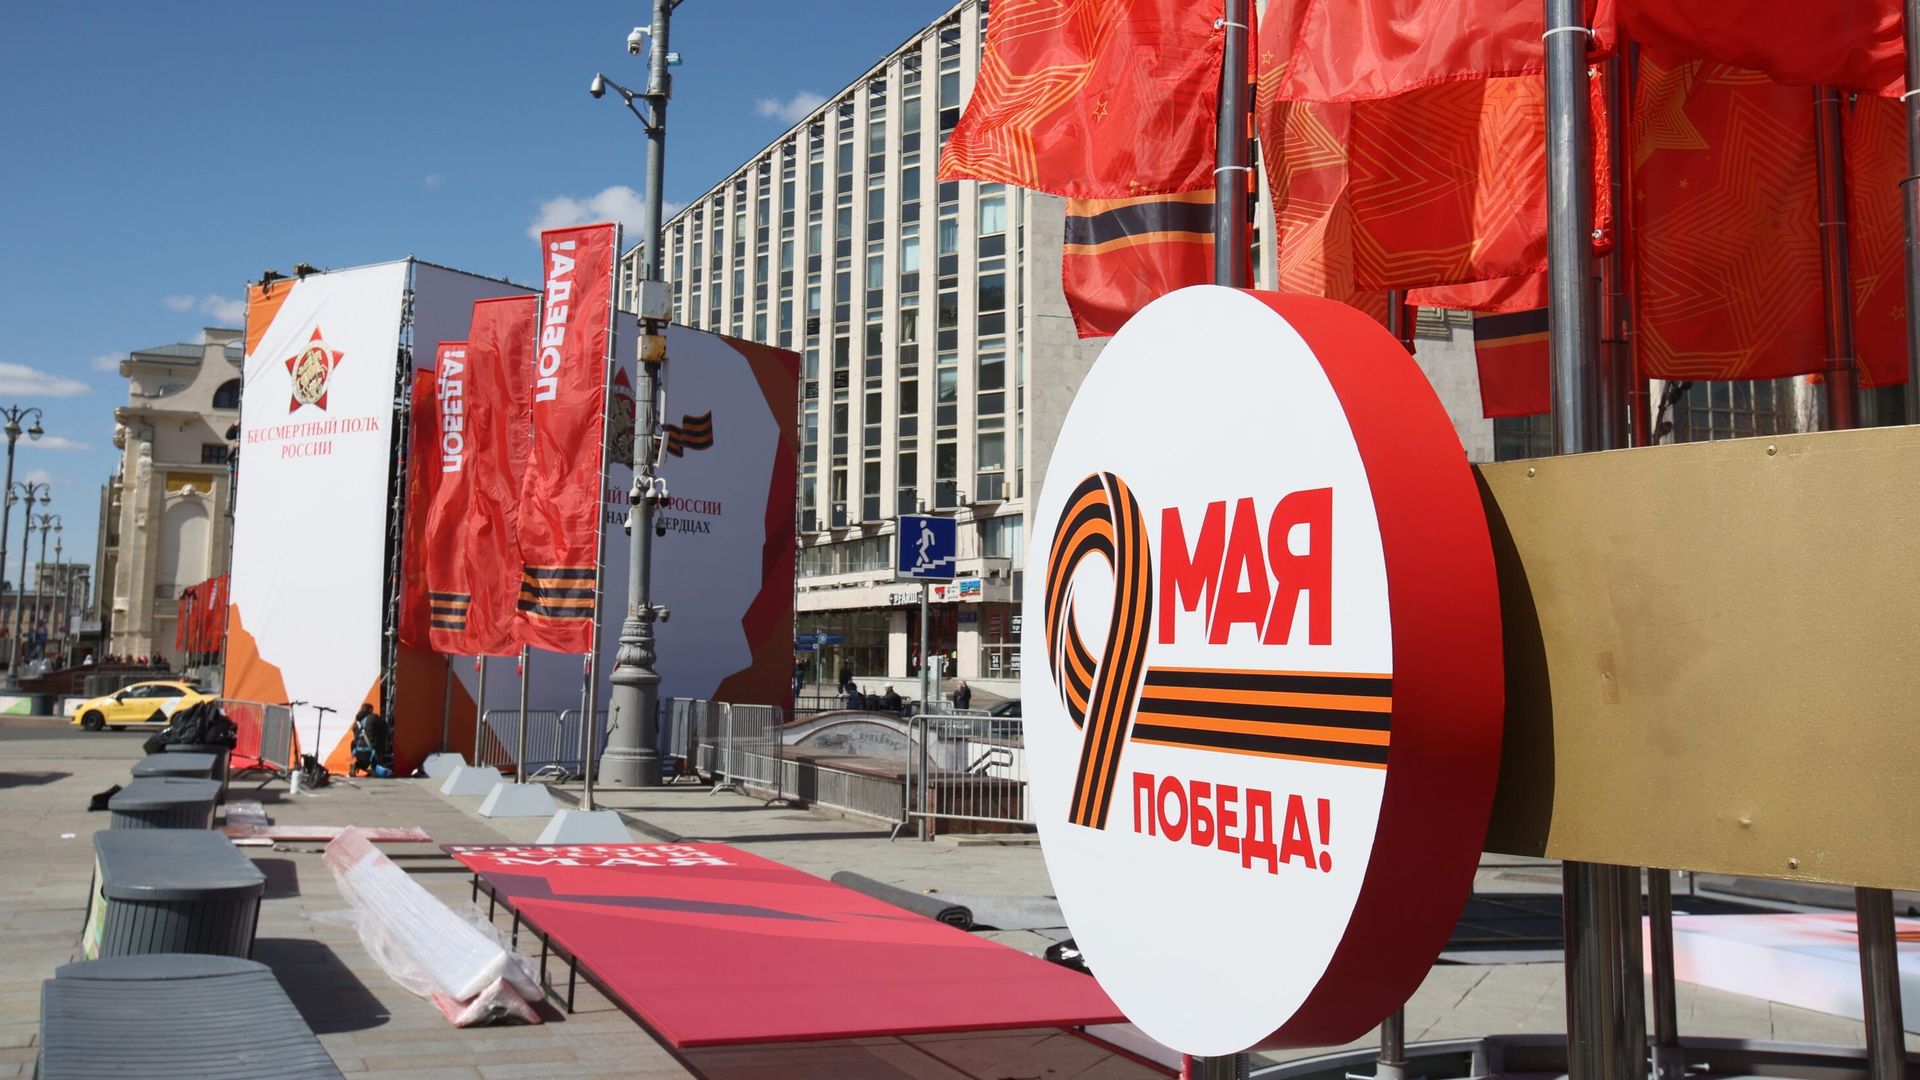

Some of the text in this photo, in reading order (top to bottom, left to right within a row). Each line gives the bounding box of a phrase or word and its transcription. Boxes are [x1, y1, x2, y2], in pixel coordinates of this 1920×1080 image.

[247, 416, 380, 443] БЕССМЕРТНЫЙ ПОЛК
[281, 441, 333, 459] РОССИИ
[668, 497, 722, 515] РОССИИ
[664, 517, 711, 534] ЕРДЦАХ
[1158, 487, 1333, 646] МАЯ
[1133, 772, 1332, 874] ПОБЕДА!
[489, 857, 737, 867] МАЯ
